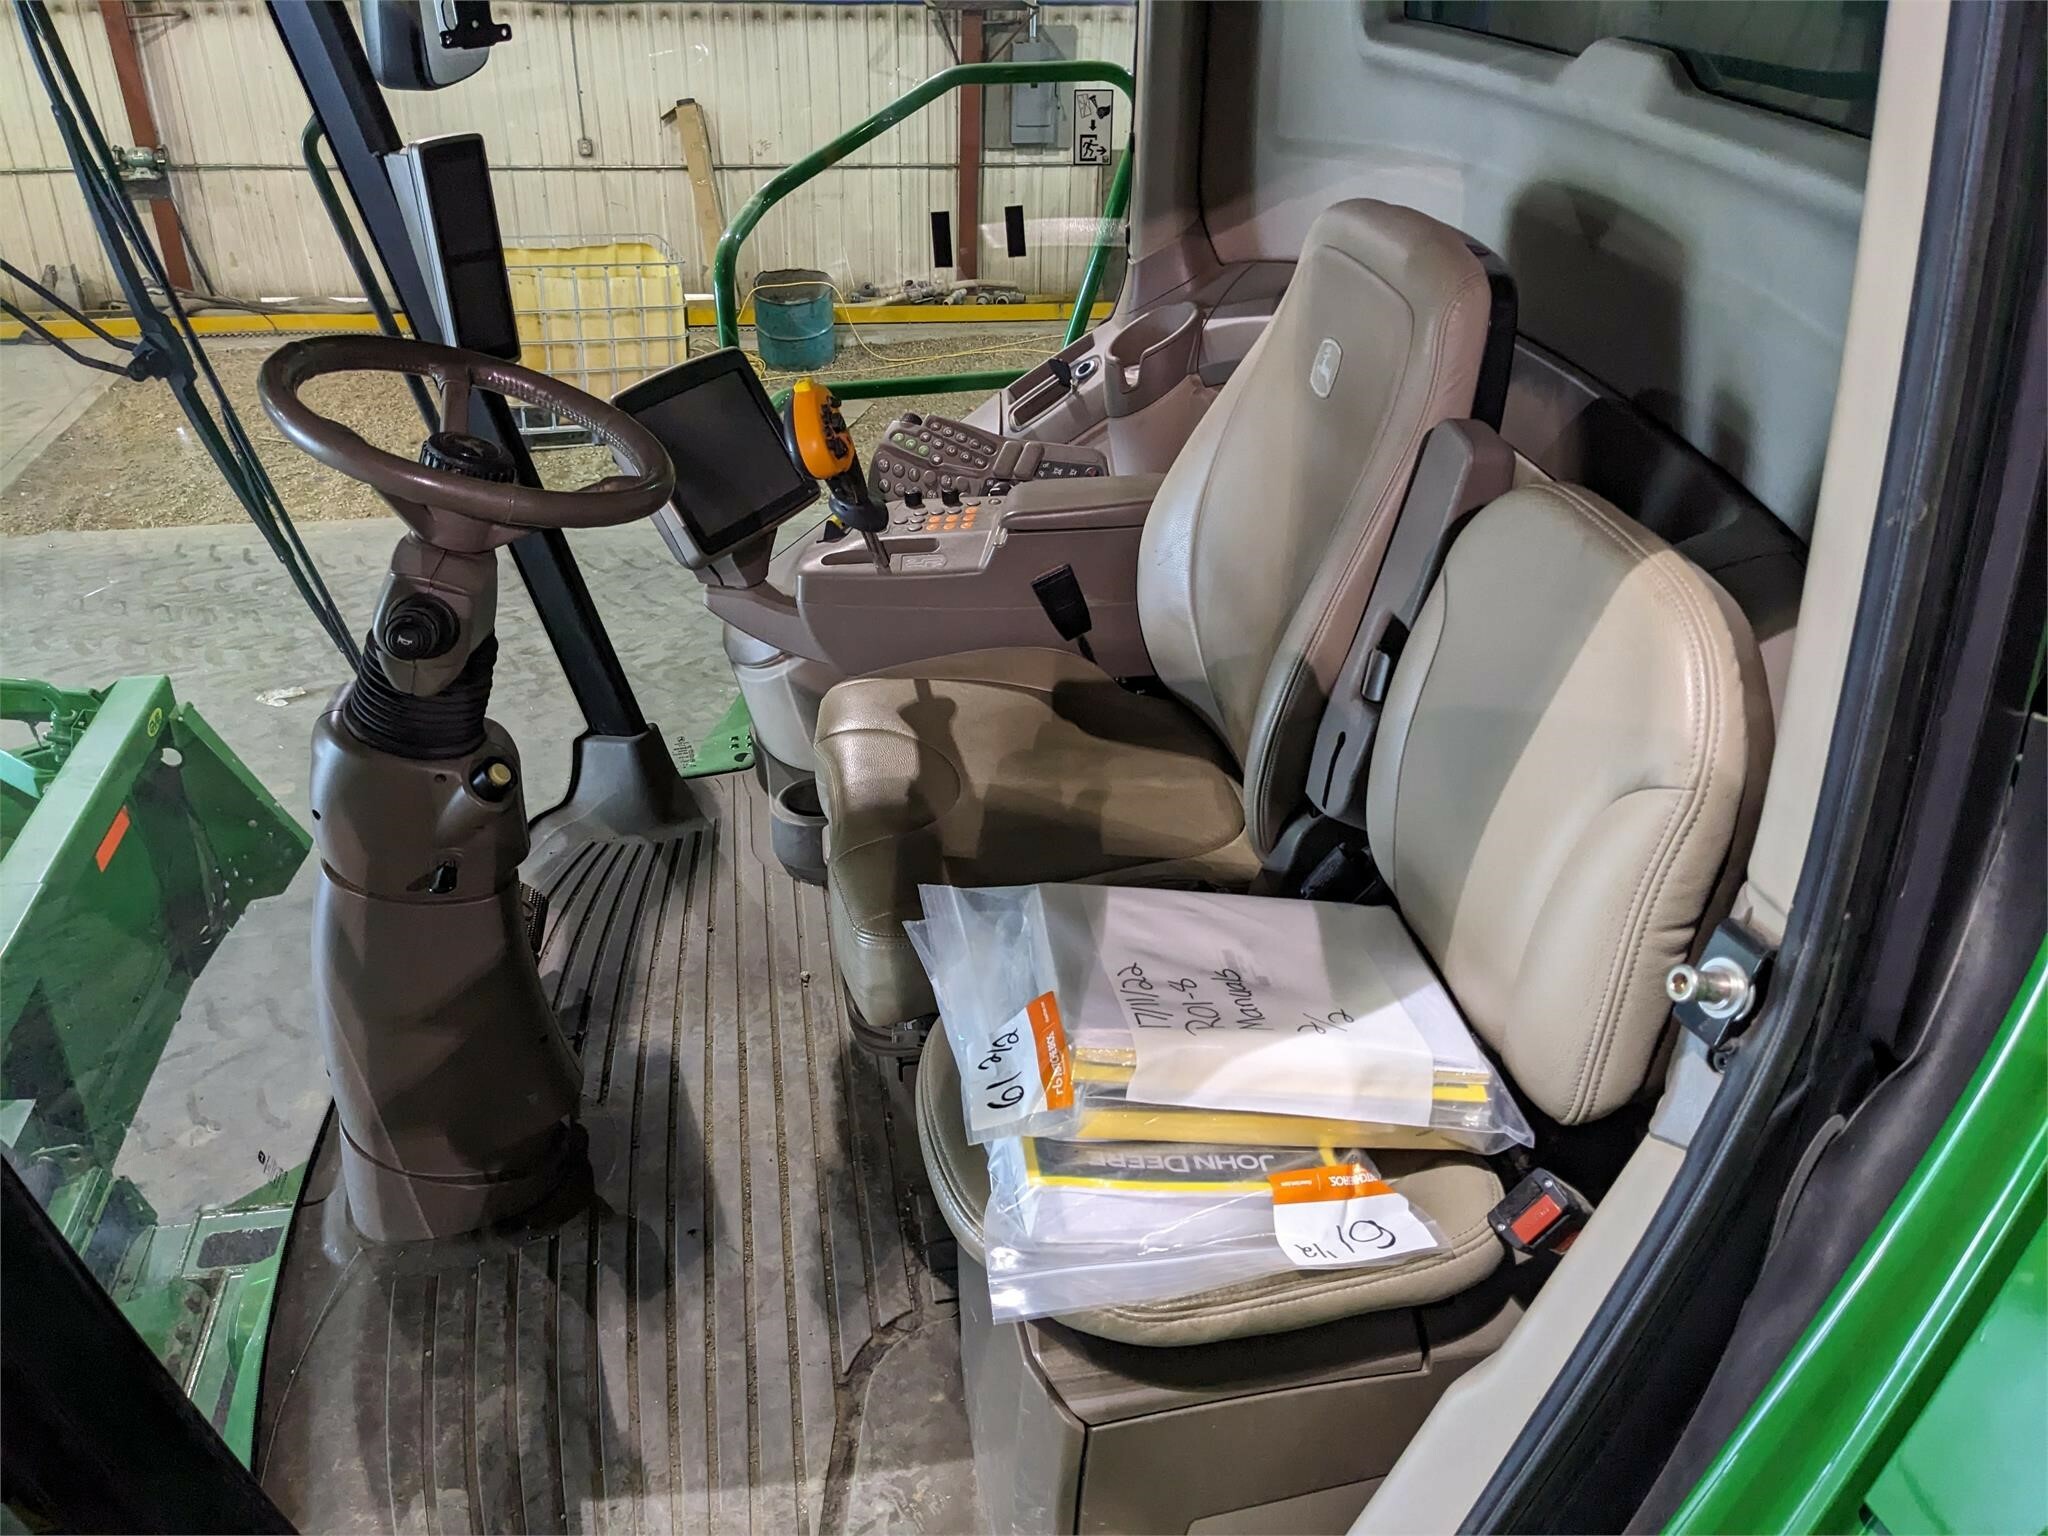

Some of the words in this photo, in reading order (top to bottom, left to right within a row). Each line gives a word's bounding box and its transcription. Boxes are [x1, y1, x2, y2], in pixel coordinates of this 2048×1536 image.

[1117, 962, 1174, 1028] 17/11/22
[1211, 968, 1275, 1030] Manuals
[986, 1071, 1025, 1109] 61
[1087, 1151, 1191, 1173] DEERE
[1193, 1154, 1275, 1172] JOHN
[1336, 1219, 1396, 1254] 61
